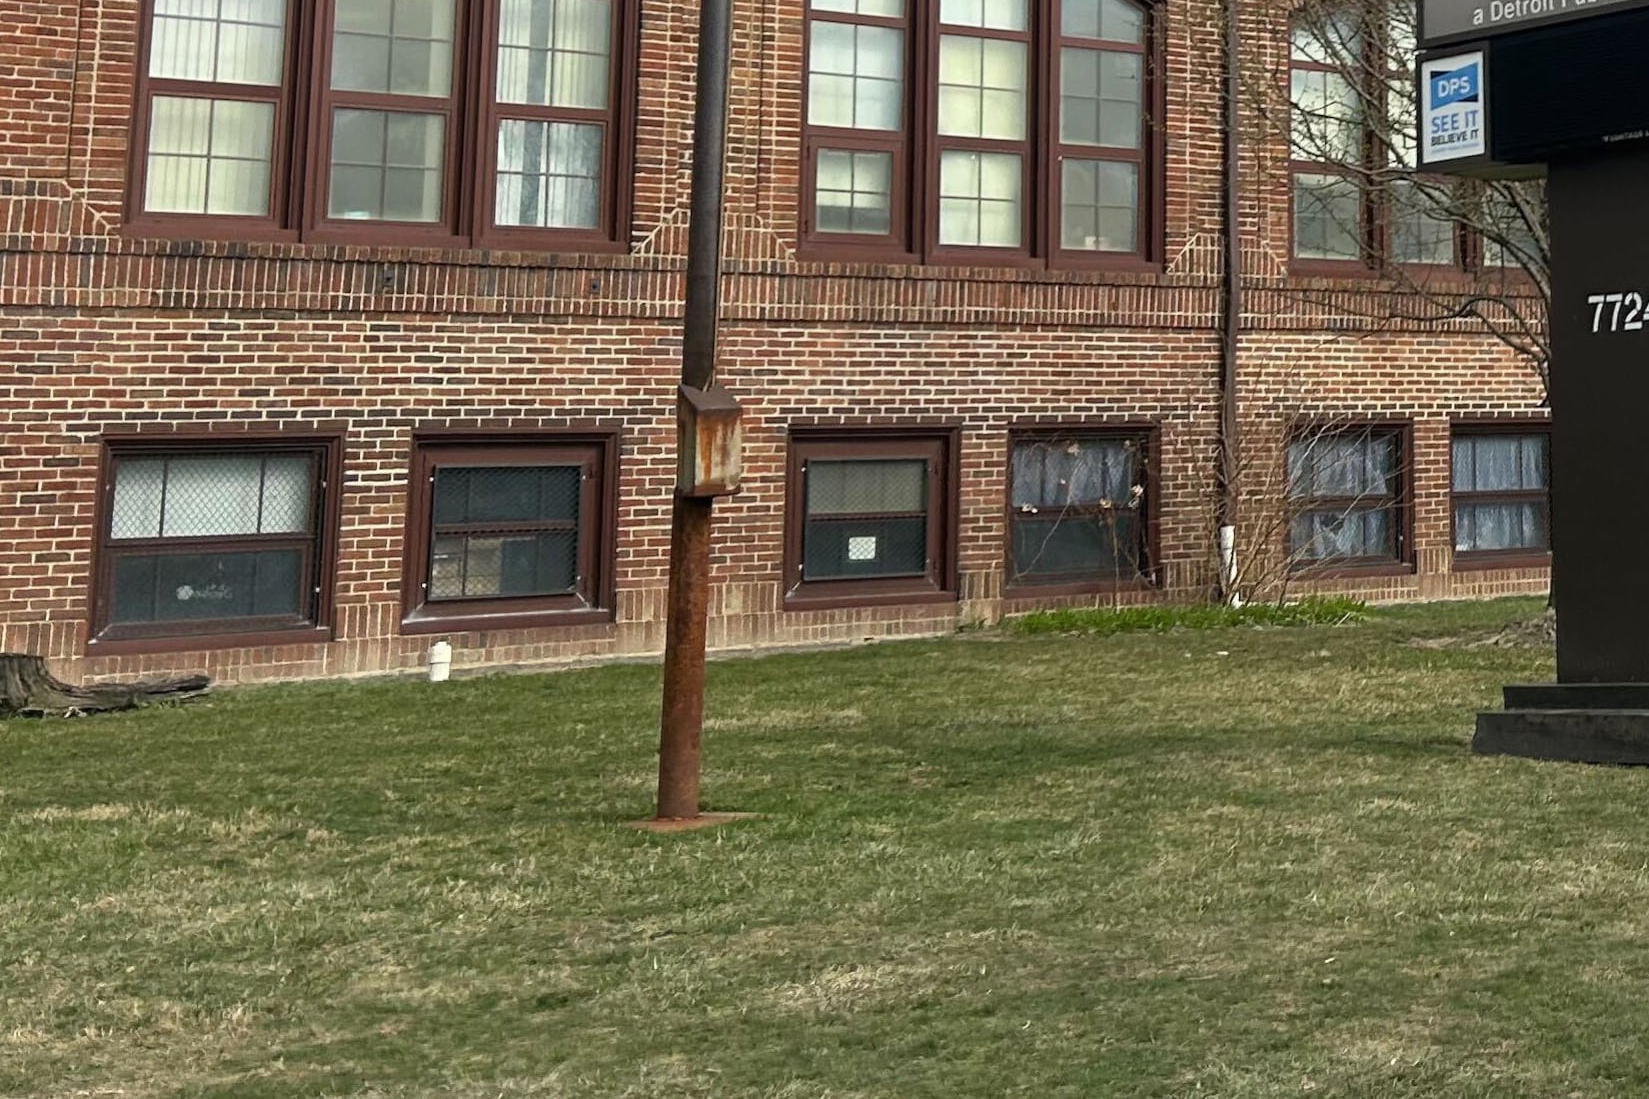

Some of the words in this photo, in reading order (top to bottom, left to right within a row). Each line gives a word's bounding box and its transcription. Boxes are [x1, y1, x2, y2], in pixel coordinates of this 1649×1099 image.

[1473, 7, 1483, 25] a
[1438, 76, 1471, 98] DPS
[1431, 113, 1460, 134] SEE
[1464, 110, 1479, 129] IT
[1431, 130, 1468, 146] BELIEVE
[1470, 128, 1480, 140] IT
